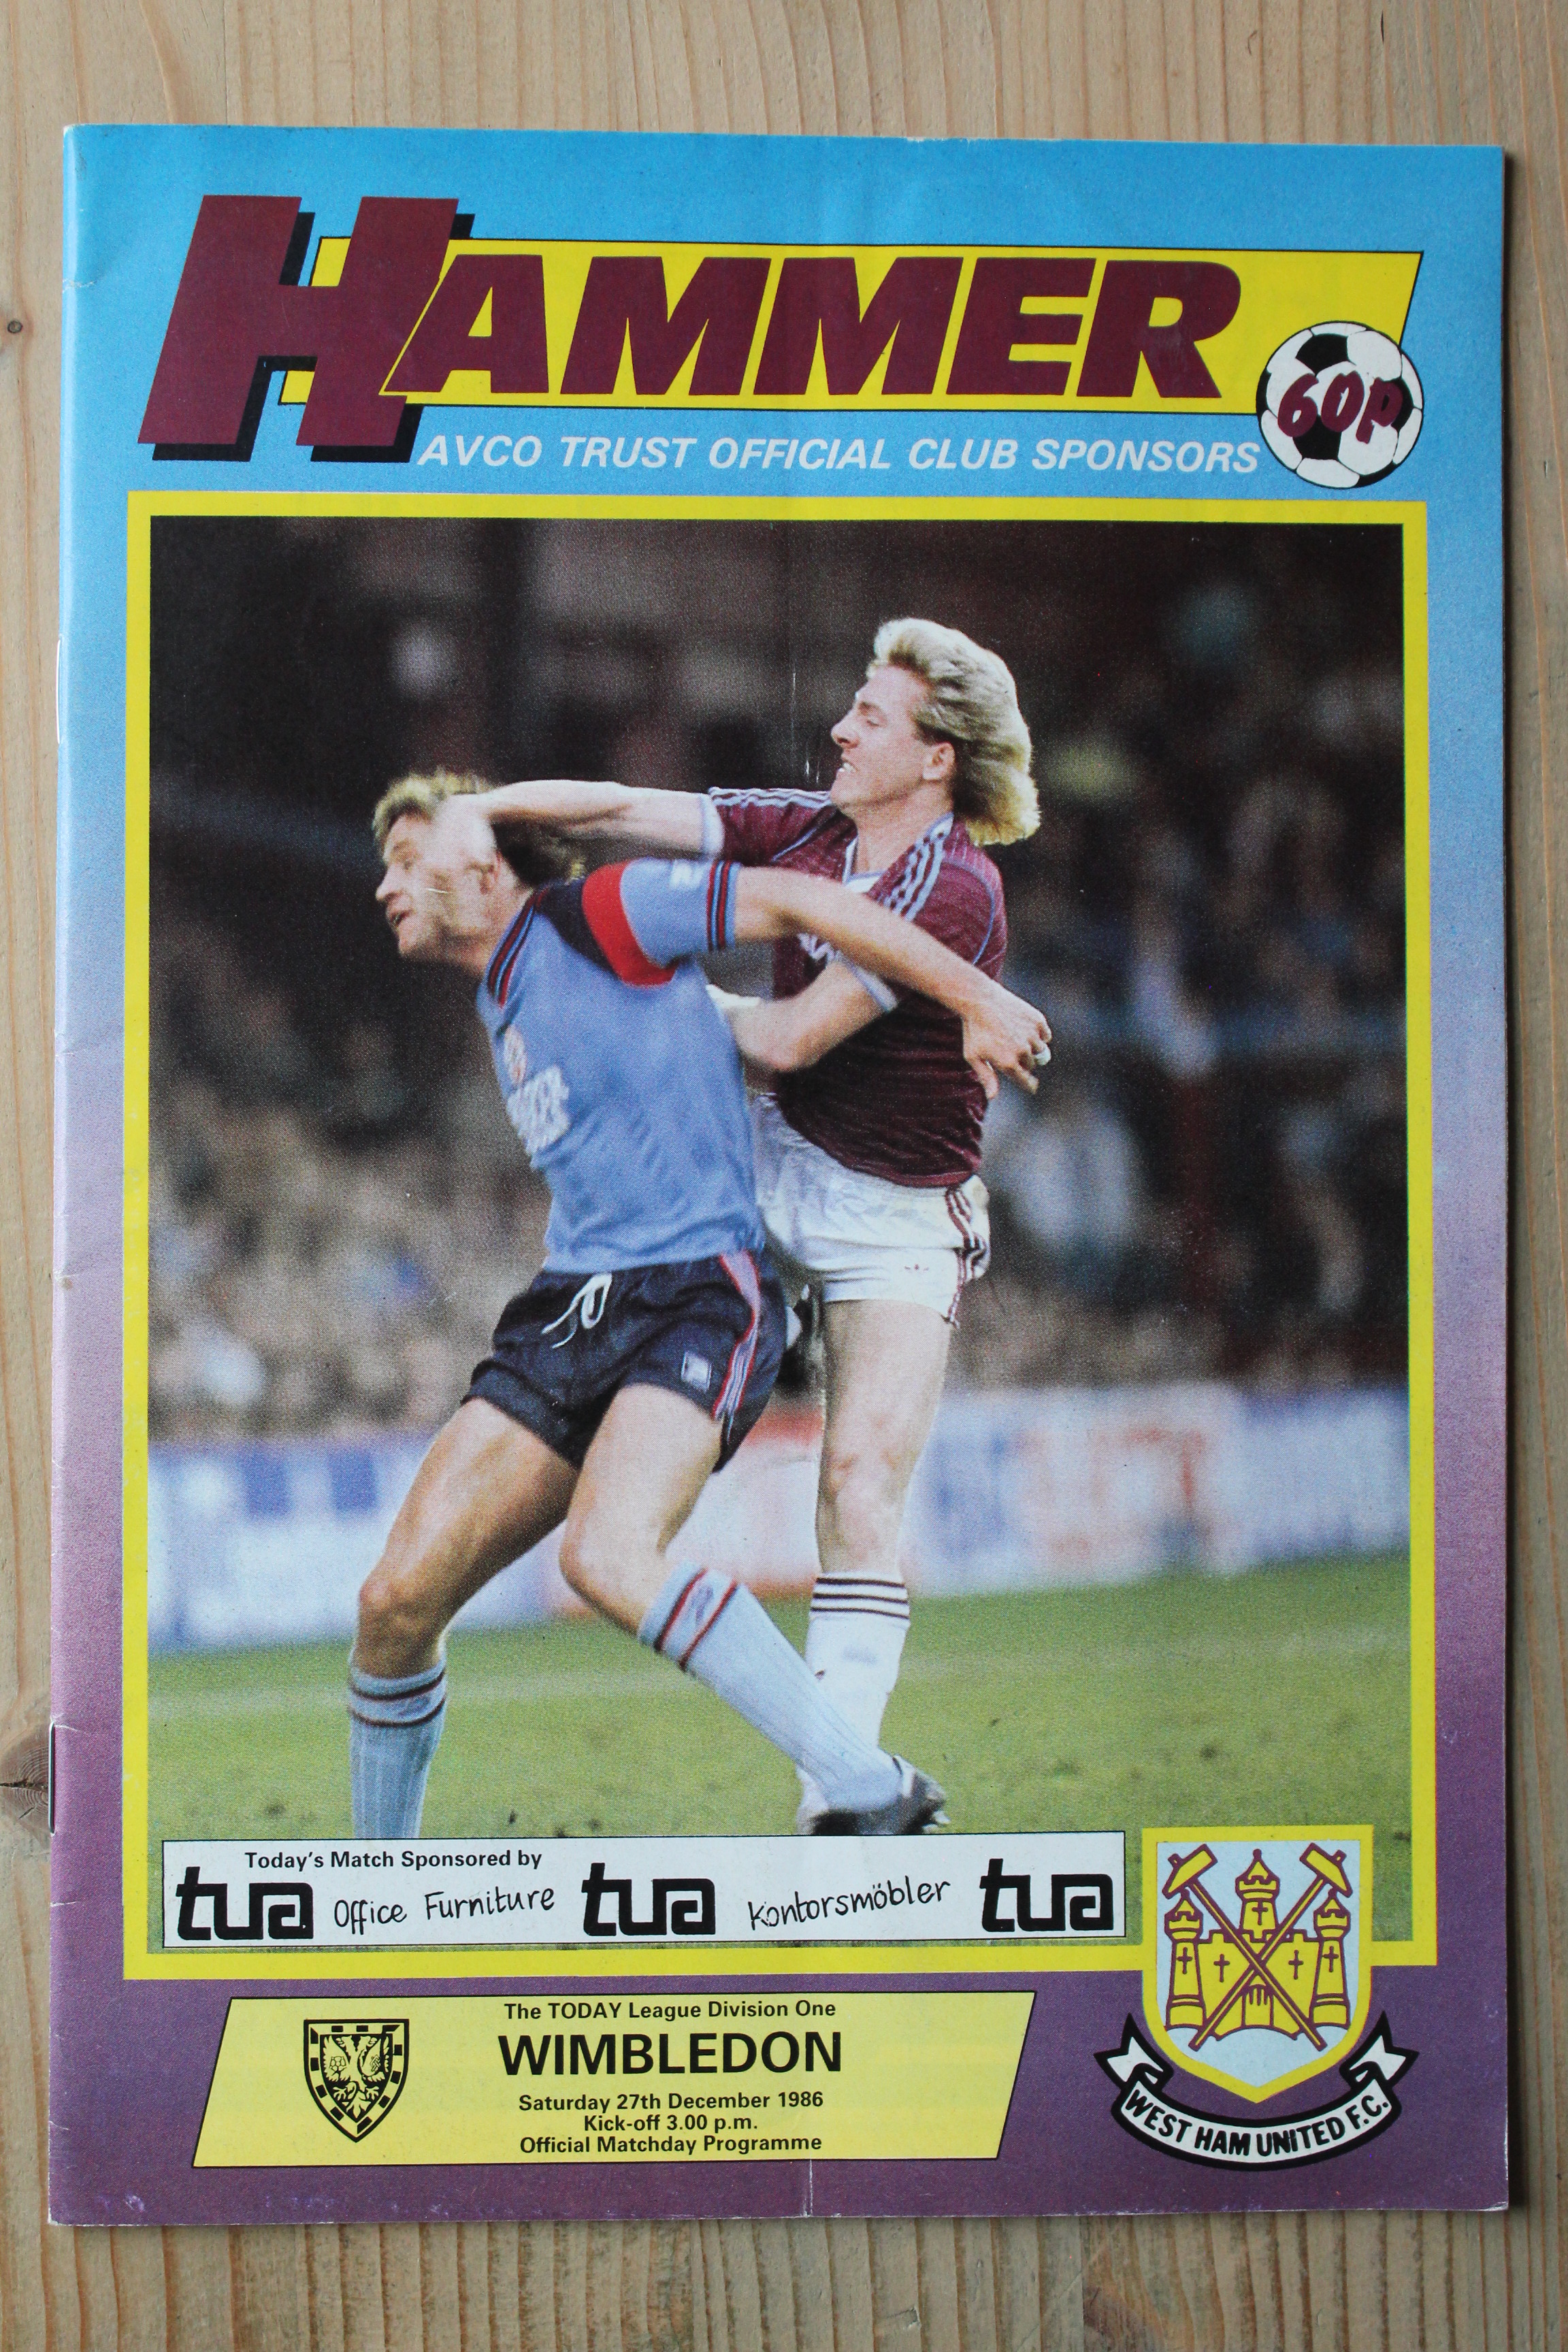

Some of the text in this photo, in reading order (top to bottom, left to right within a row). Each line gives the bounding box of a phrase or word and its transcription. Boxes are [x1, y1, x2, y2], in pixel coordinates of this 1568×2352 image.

[137, 195, 1241, 446] HAMMER
[417, 435, 1260, 472] AVCO TRUST OFFICIAL CLUB SPONSORS
[245, 1850, 542, 1872] Today's Match Sponsored by
[334, 1886, 554, 1935] Office Furniture
[504, 2000, 835, 2021] The TODAY League Division One
[498, 2031, 840, 2075] WIMBLEDON
[519, 2091, 823, 2113] Saturday 27th December 1986
[585, 2114, 757, 2134] Kick-off 3.00 p.m.
[1125, 2089, 1390, 2157] WEST HAM UNITED F.C.
[521, 2136, 821, 2155] Official Matchday Programme
